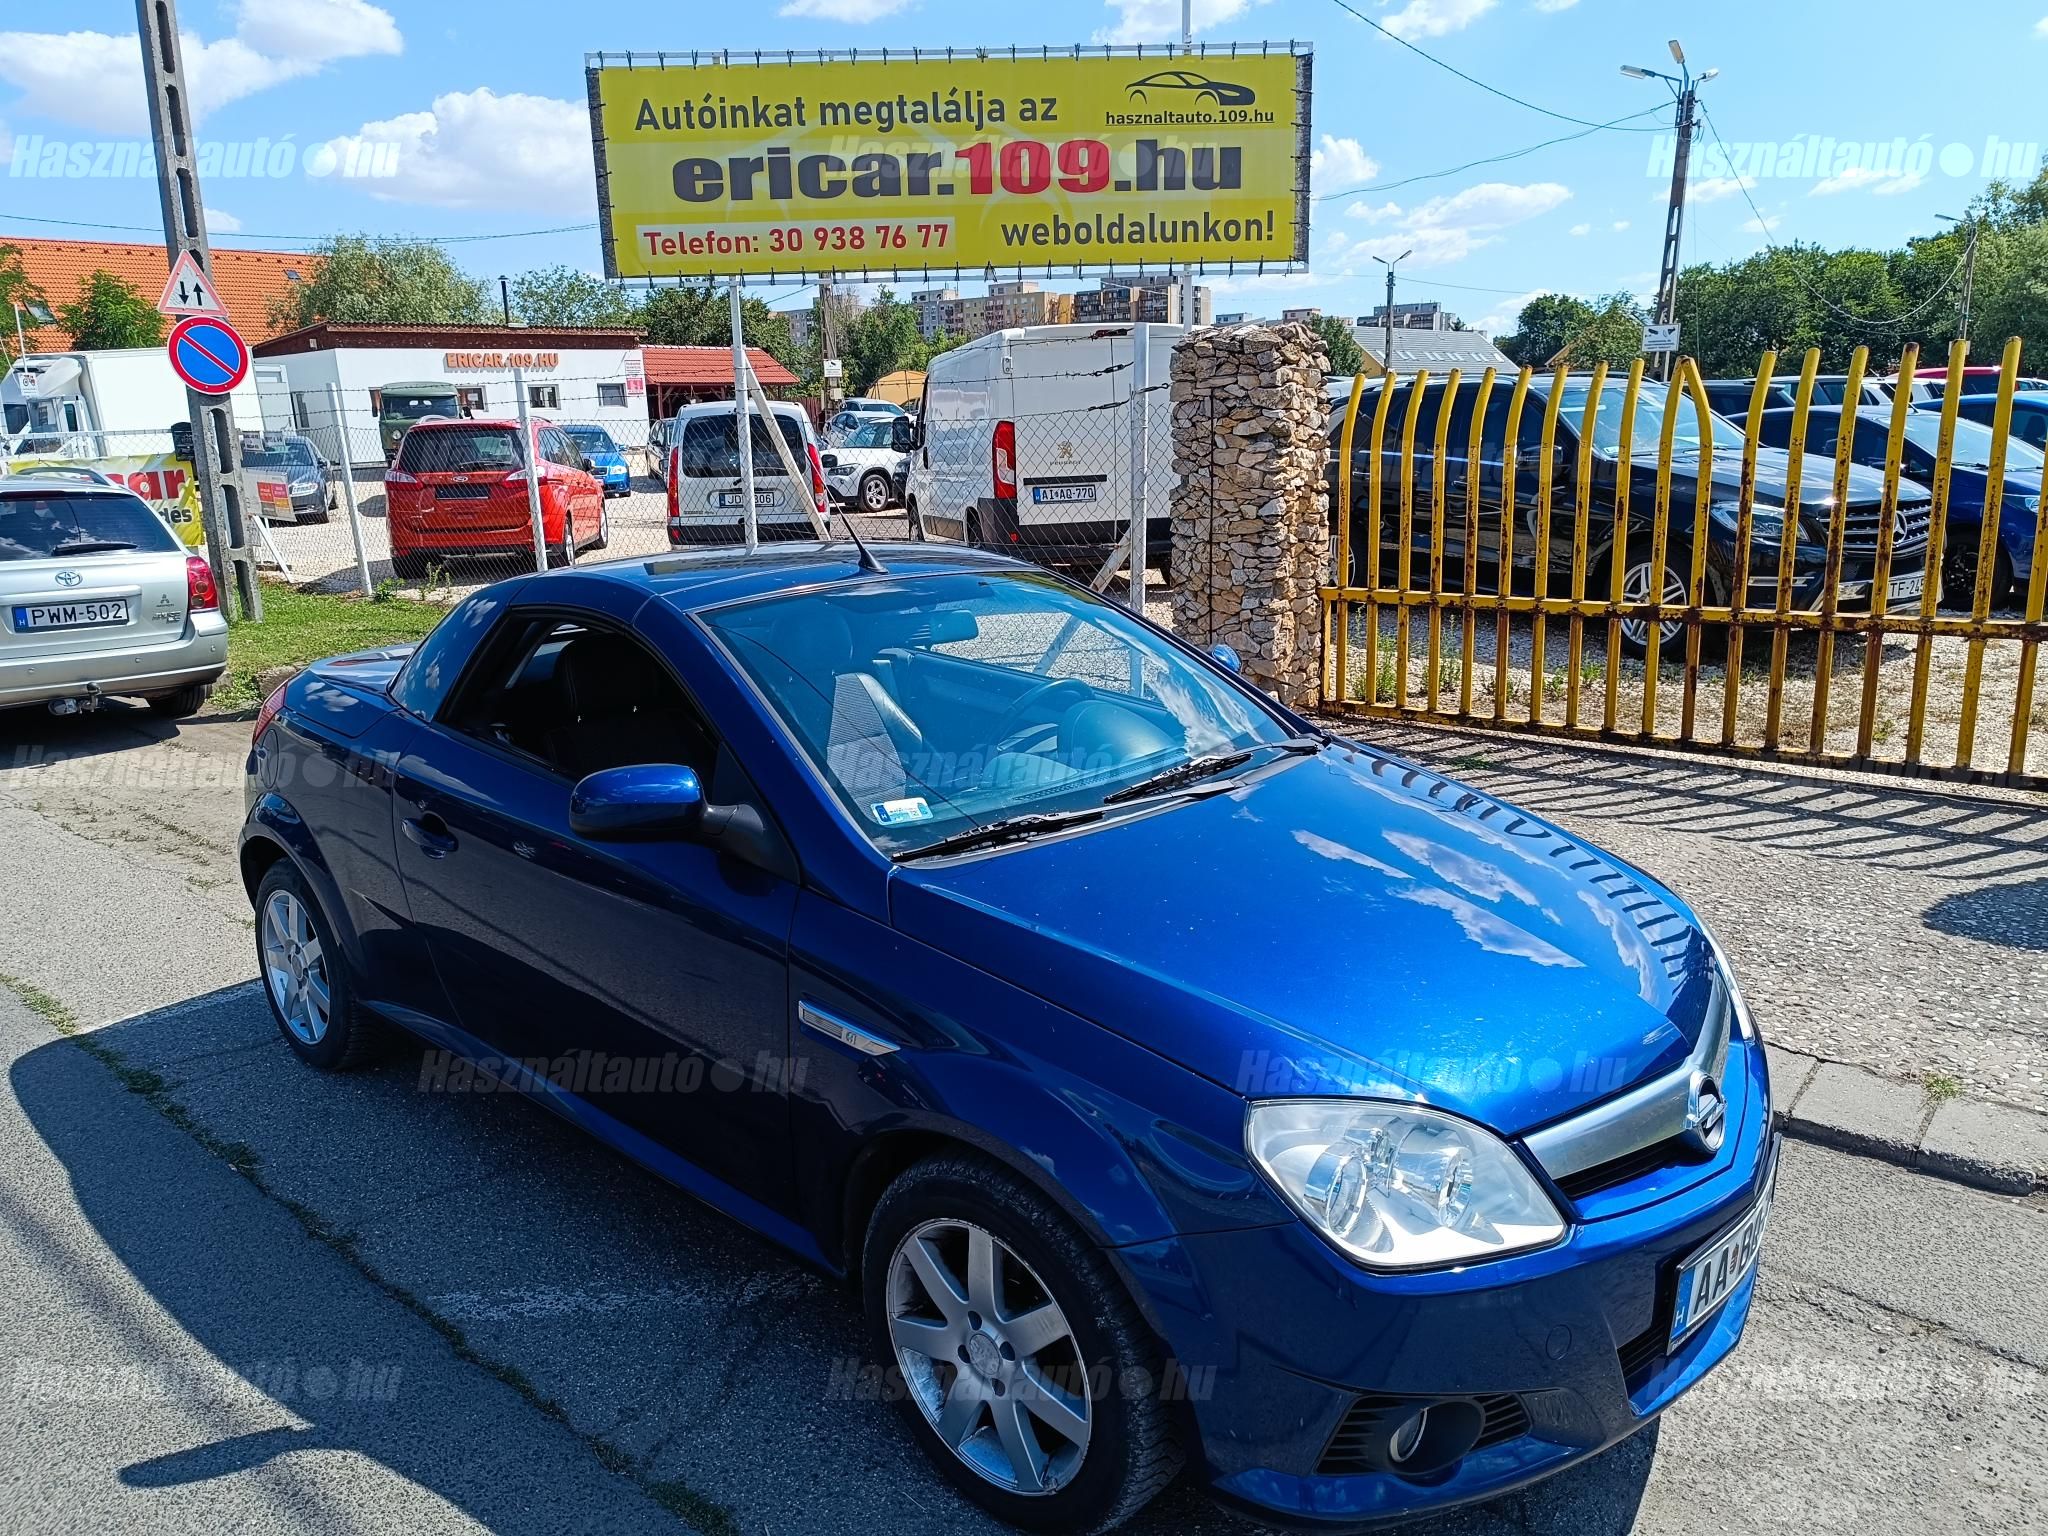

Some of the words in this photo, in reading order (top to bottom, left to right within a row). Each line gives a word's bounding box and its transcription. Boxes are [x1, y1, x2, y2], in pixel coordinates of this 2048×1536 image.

[635, 93, 805, 130] Autóinkat
[820, 87, 1005, 132] megtalálja
[1019, 97, 1057, 122] az
[1105, 109, 1274, 125] hasznaltauto.109.hu
[672, 138, 1242, 202] ericar.109.hu
[643, 231, 759, 256] Telefon:
[769, 227, 803, 252] 30
[813, 225, 866, 251] 938
[875, 224, 907, 249] 76
[917, 223, 949, 248] 77
[1001, 210, 1274, 246] weboldalunkon!
[446, 352, 559, 368] ERICAR.109.HU
[31, 604, 123, 625] PWM-502
